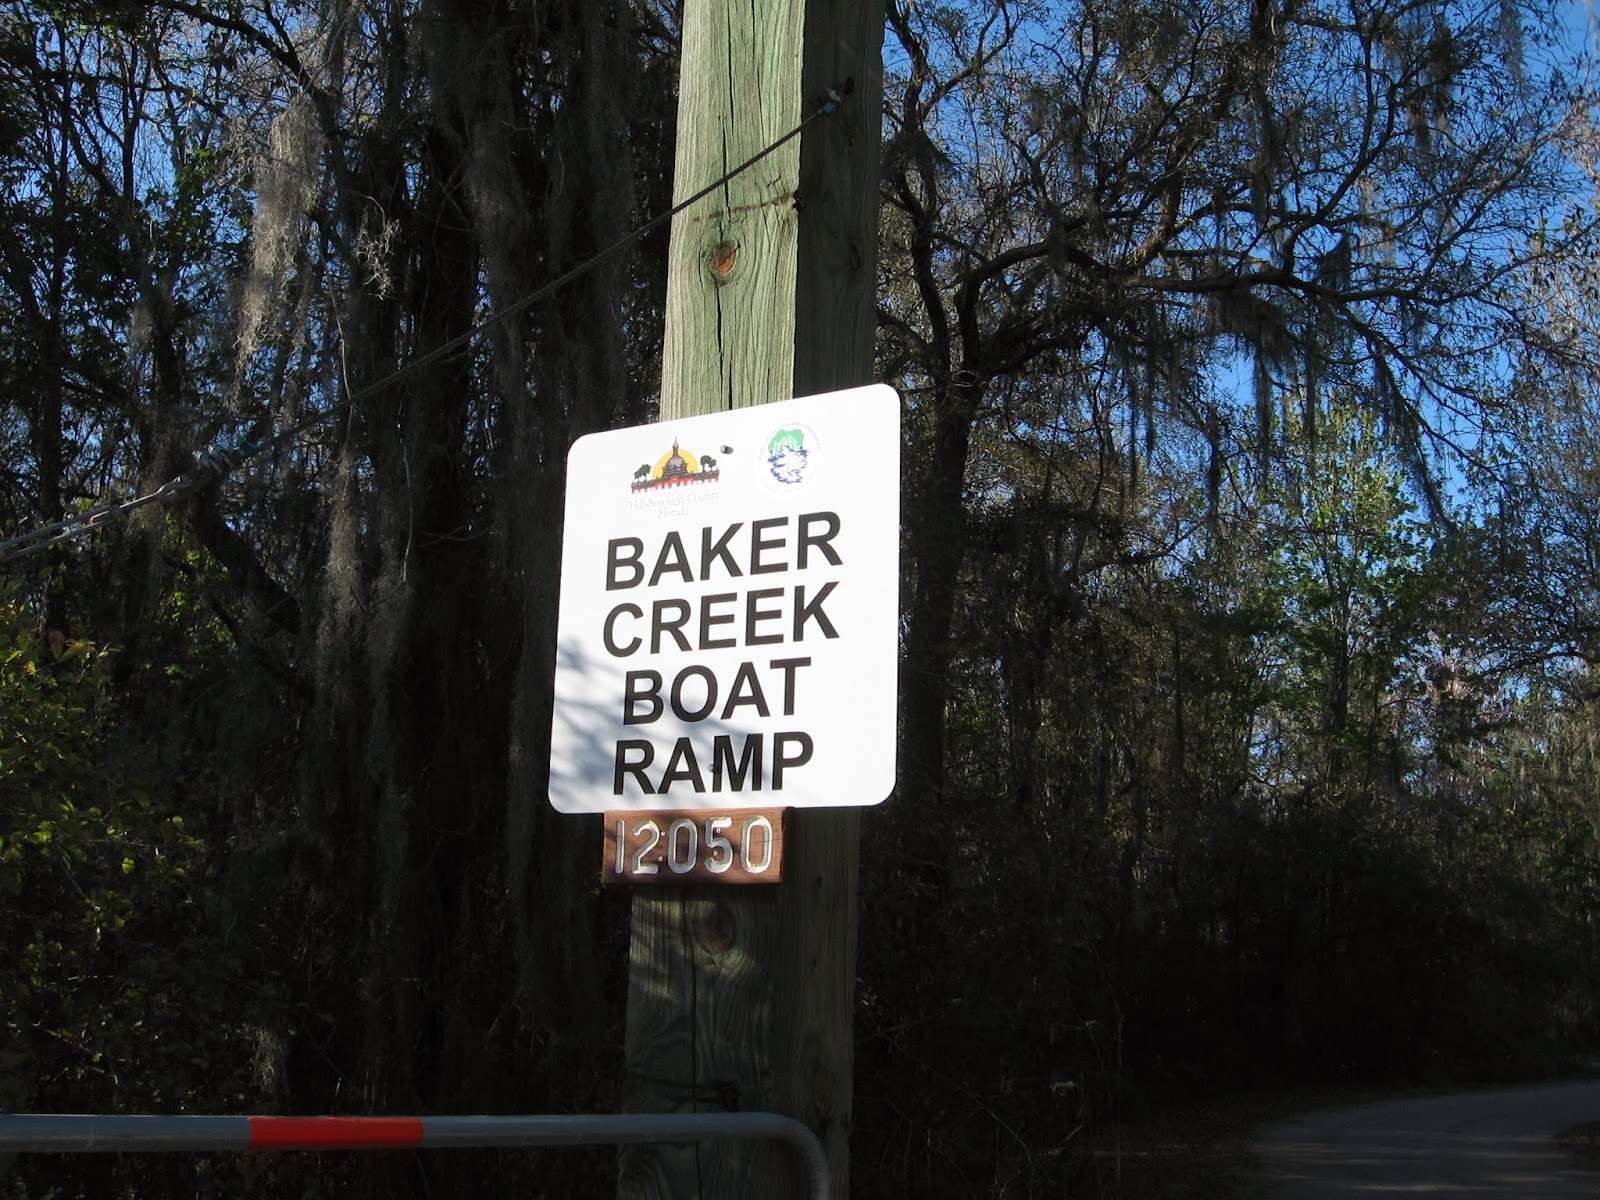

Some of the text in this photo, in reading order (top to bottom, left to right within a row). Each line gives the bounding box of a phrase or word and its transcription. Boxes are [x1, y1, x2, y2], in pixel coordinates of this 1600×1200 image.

[629, 491, 720, 511] Hillsborough County
[657, 506, 689, 519] Florida
[605, 511, 842, 591] BAKER
[603, 581, 840, 658] CREEK
[622, 656, 812, 726] BOAT
[613, 731, 814, 796] RAMP
[615, 815, 773, 875] 12050
